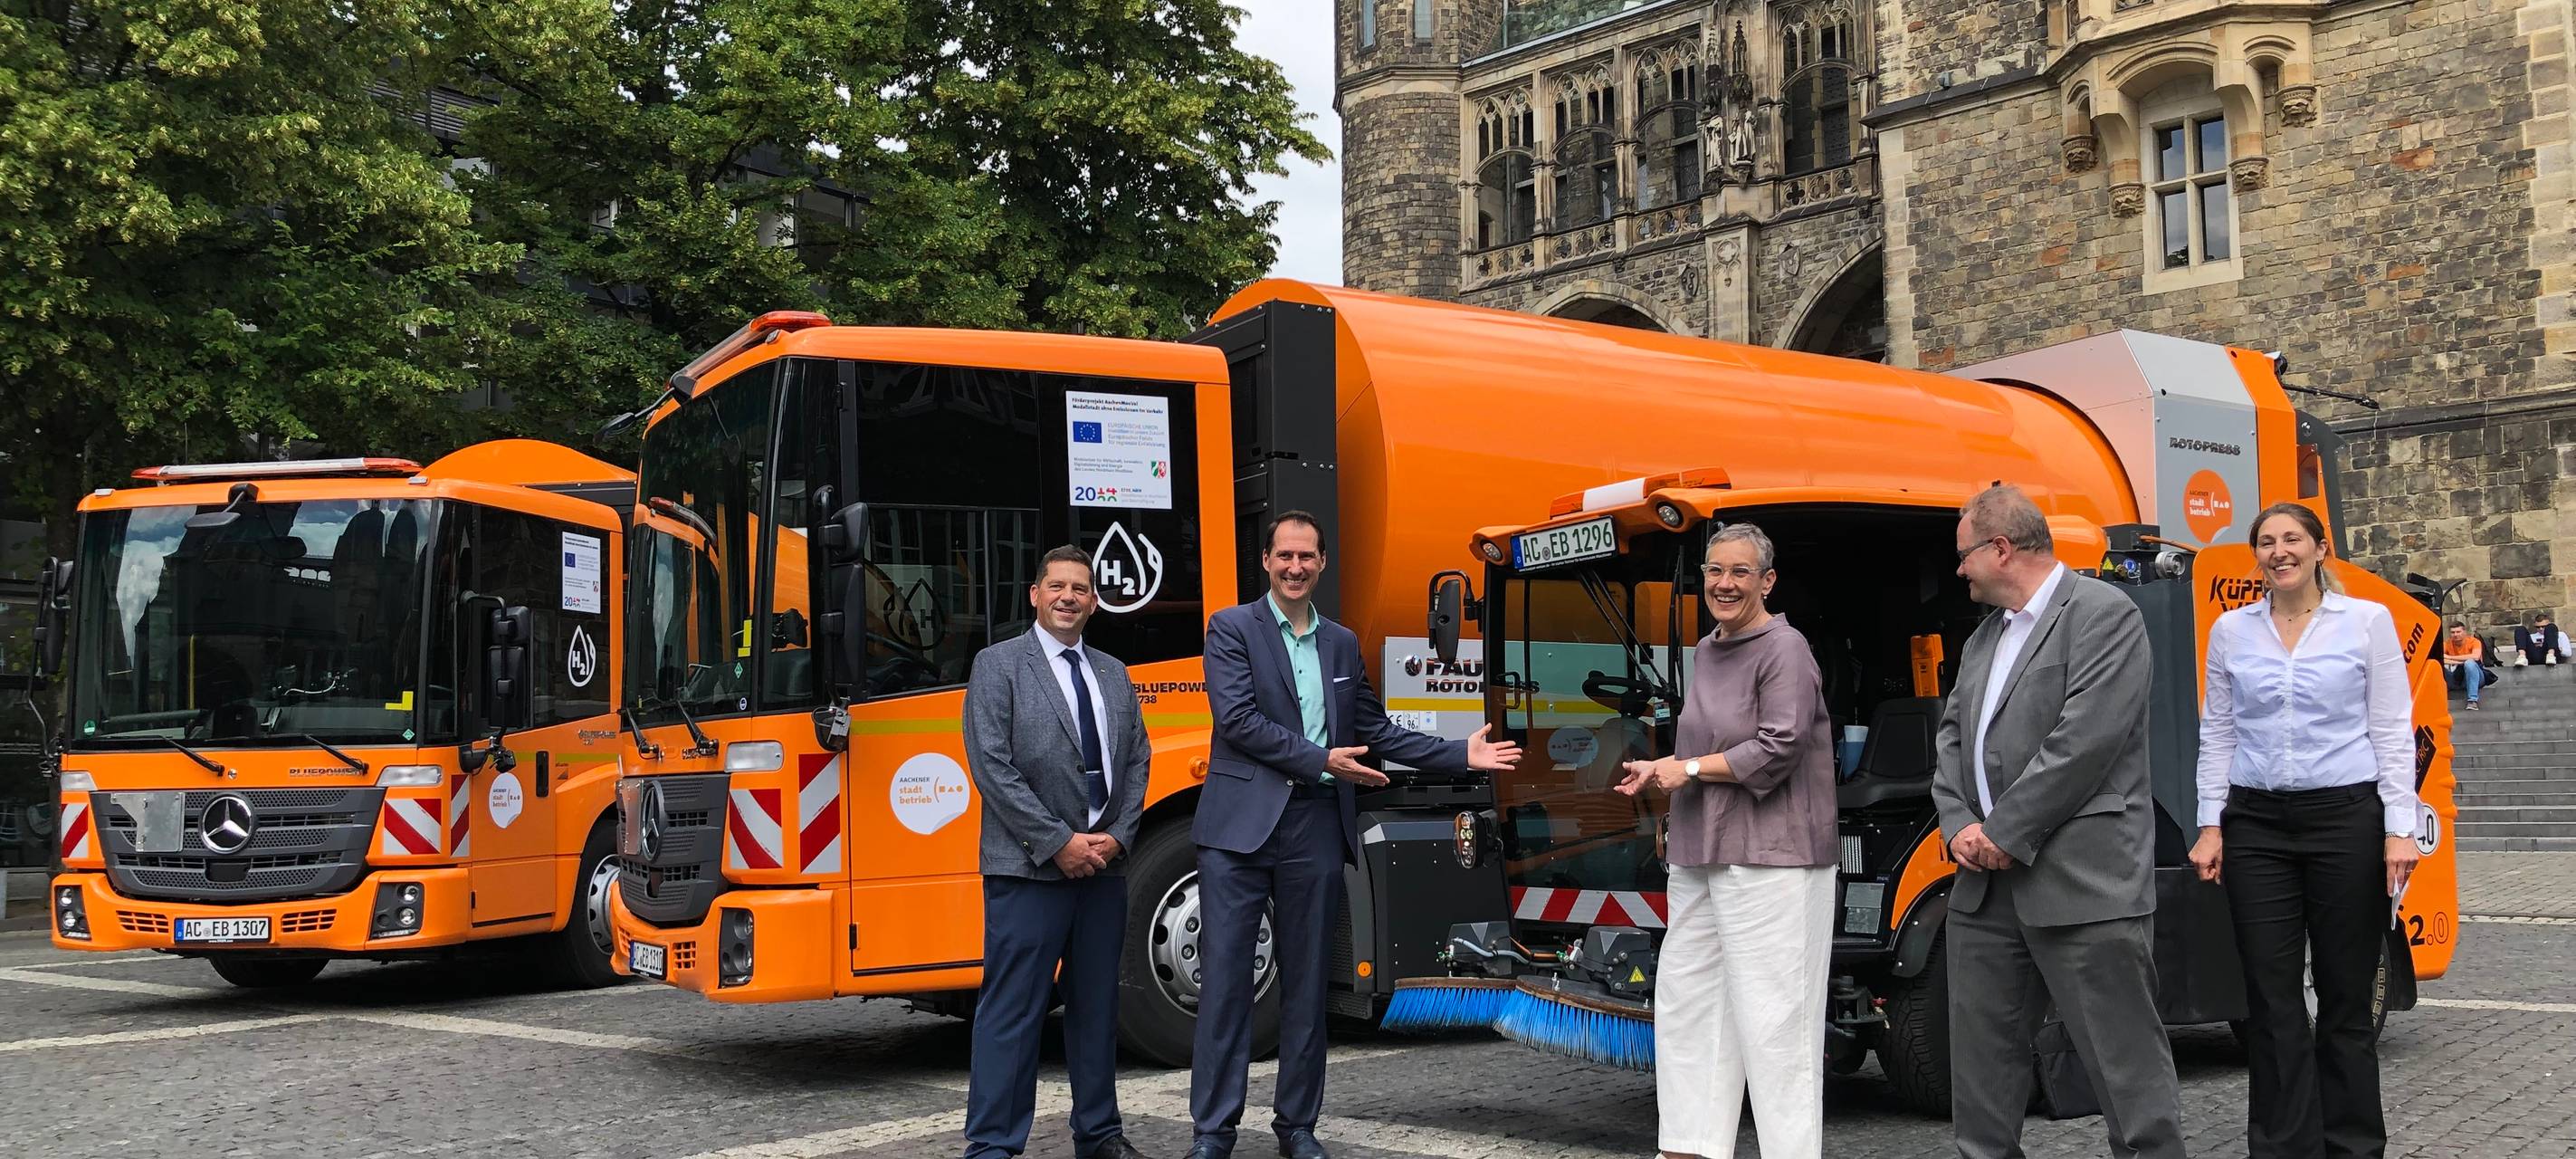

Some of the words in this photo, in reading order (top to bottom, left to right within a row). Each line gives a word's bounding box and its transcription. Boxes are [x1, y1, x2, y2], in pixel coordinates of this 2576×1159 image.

[2170, 437, 2241, 455] ROTOPRESS
[1522, 537, 1541, 563] AC
[1550, 532, 1569, 560] EB
[1572, 522, 1612, 553] 1296
[2209, 574, 2263, 603] KÜPP
[1426, 658, 1484, 676] FAU
[1132, 682, 1207, 693] BLUEPOWE
[899, 785, 923, 794] stadt
[899, 795, 932, 804] betrieb
[186, 922, 201, 937] AC
[213, 921, 229, 936] EB
[234, 920, 266, 936] 1307
